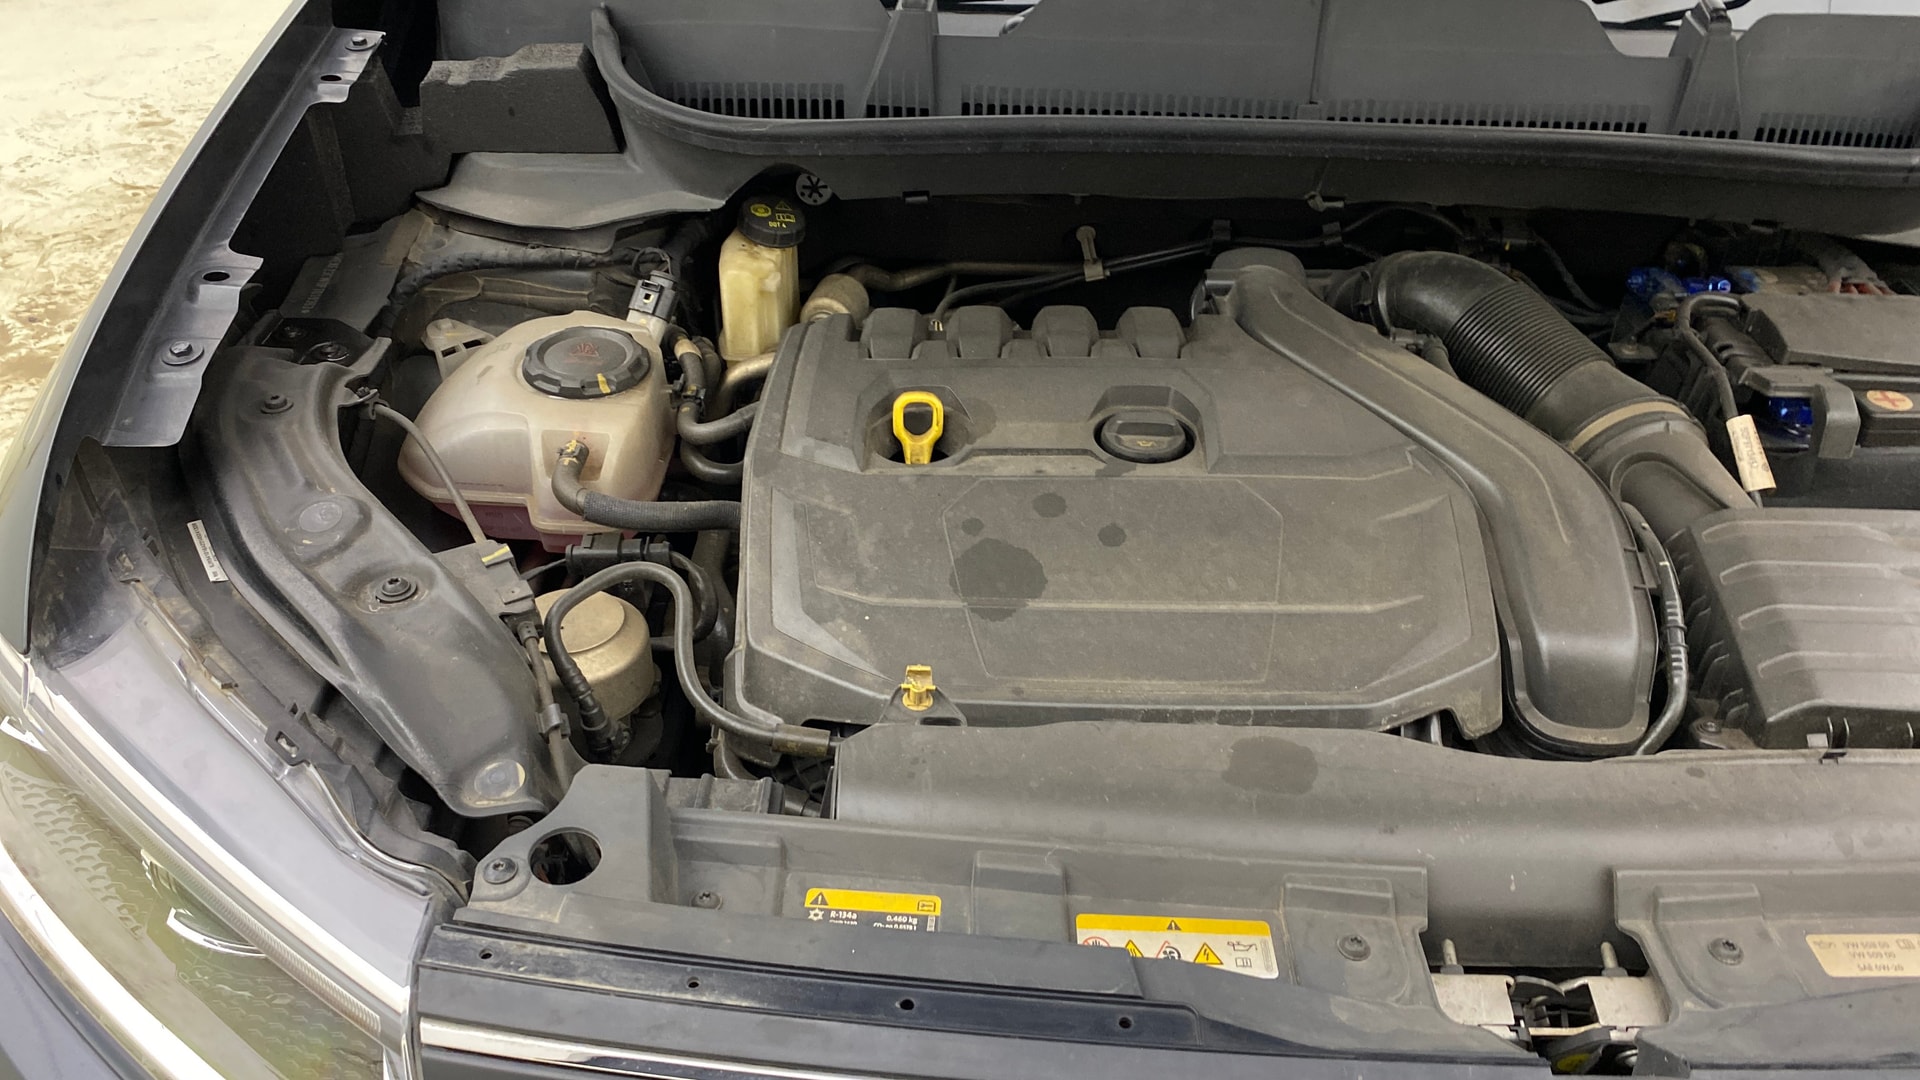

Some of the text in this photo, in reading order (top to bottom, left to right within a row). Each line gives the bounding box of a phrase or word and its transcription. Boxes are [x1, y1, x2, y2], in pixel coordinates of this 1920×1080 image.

[830, 910, 857, 920] R-134a
[886, 915, 907, 923] 0.460
[909, 916, 918, 925] kg
